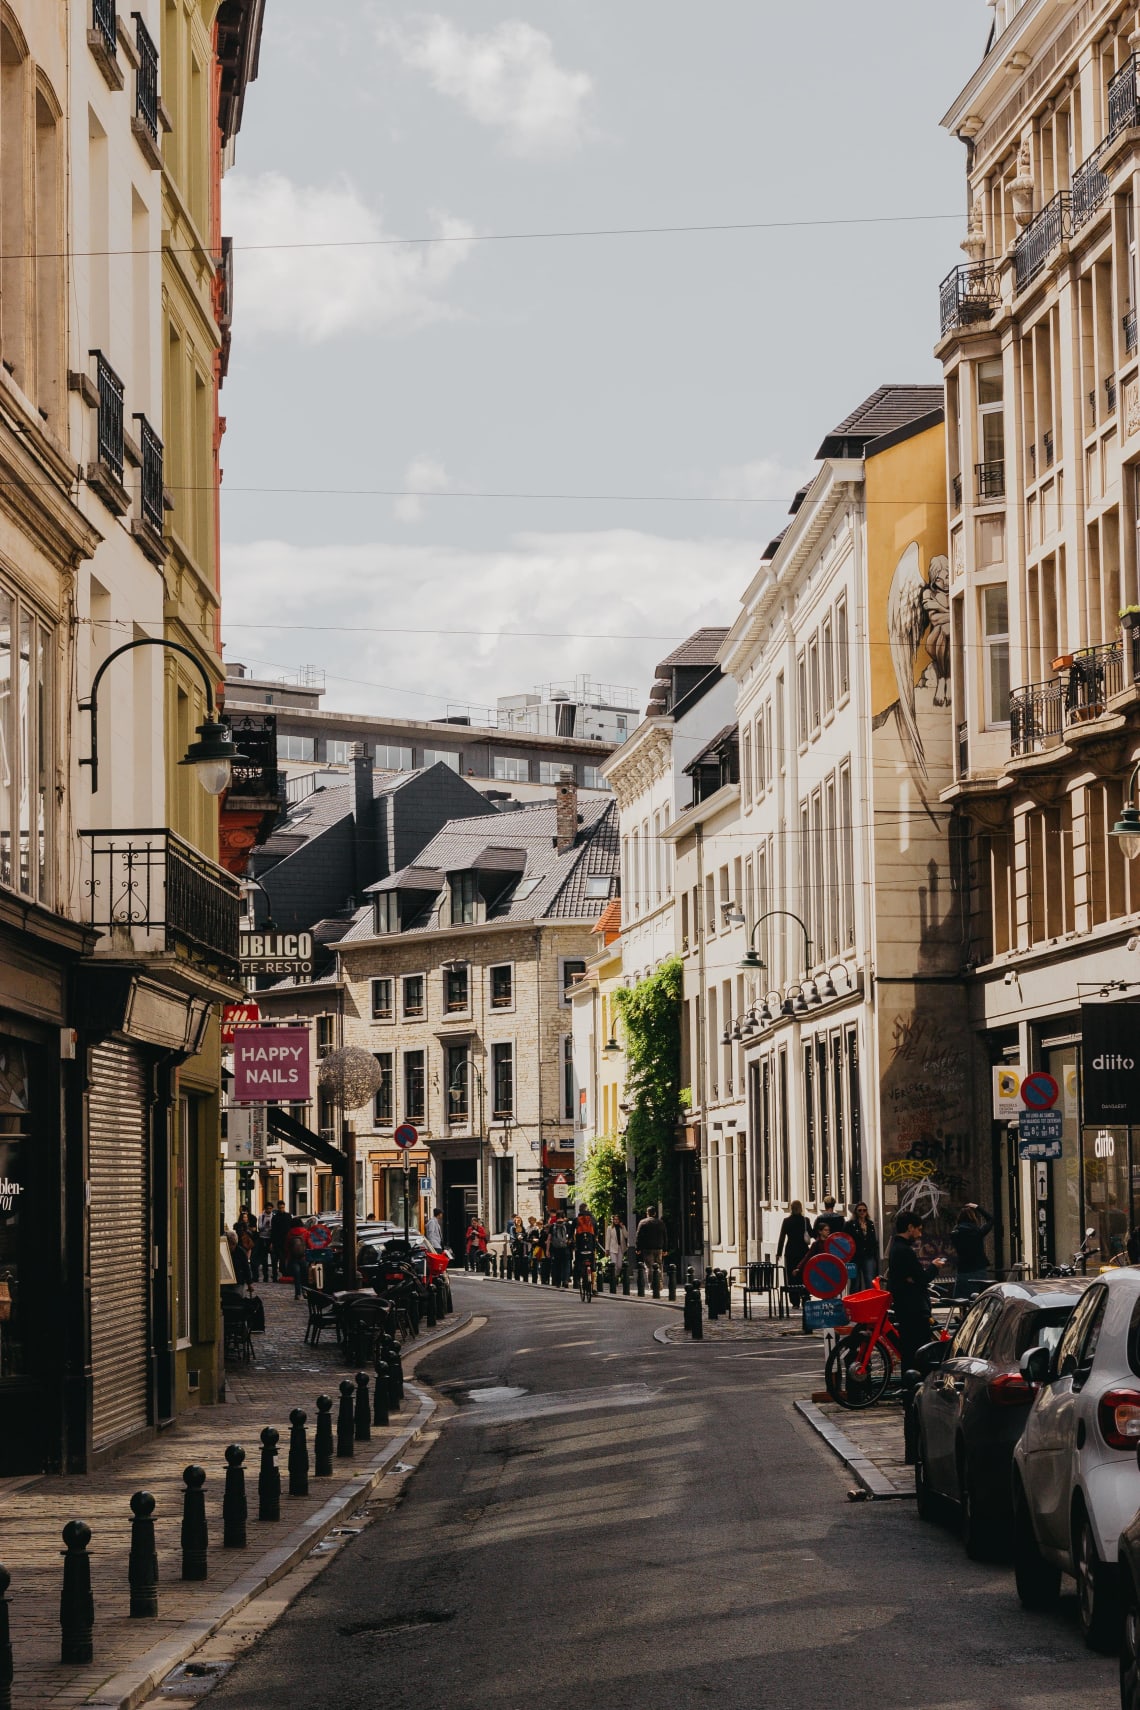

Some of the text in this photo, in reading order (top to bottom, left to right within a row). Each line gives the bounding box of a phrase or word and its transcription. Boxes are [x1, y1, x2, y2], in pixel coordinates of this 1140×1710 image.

[239, 932, 312, 959] UBLICO
[241, 961, 312, 973] FE-RESTO
[241, 1046, 303, 1062] HAPPY
[1092, 1054, 1135, 1070] diito
[246, 1068, 298, 1083] NAILS
[1094, 1129, 1115, 1158] diito
